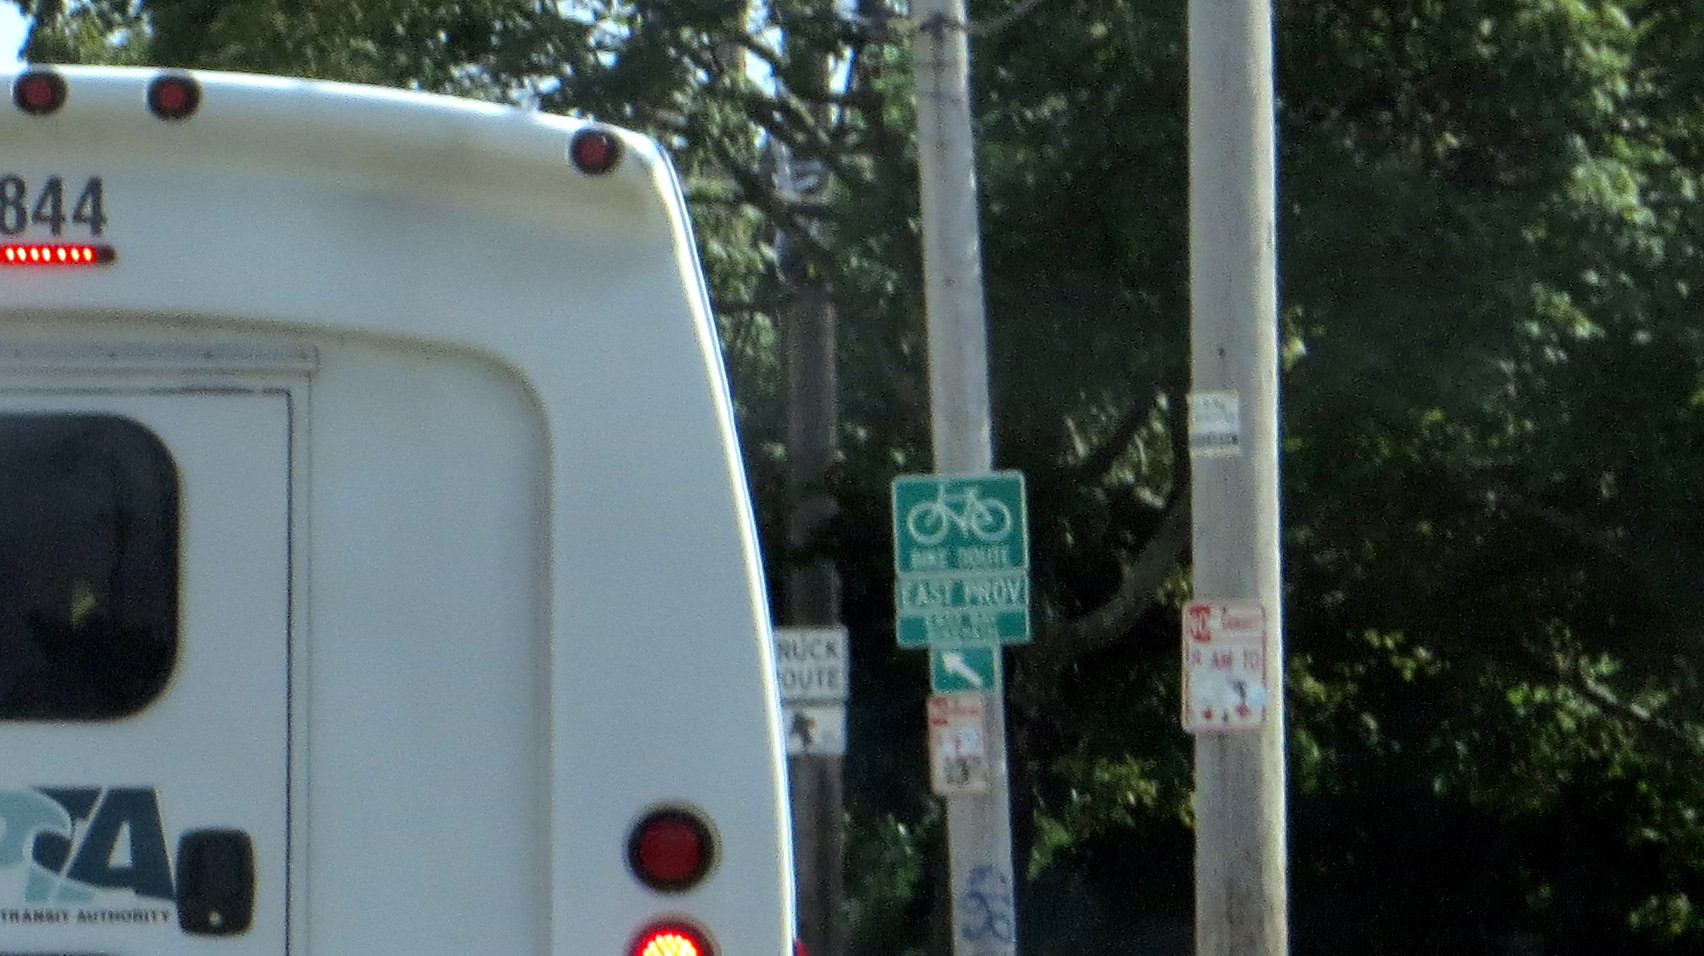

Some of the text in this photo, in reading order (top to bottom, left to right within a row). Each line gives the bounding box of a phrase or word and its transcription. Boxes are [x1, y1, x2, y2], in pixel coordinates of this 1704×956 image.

[901, 576, 1023, 606] EAST PROV
[777, 640, 839, 661] RUCK
[782, 667, 839, 689] OUTE
[0, 910, 69, 924] TRANSIT
[76, 910, 170, 924] AUTHORITY
